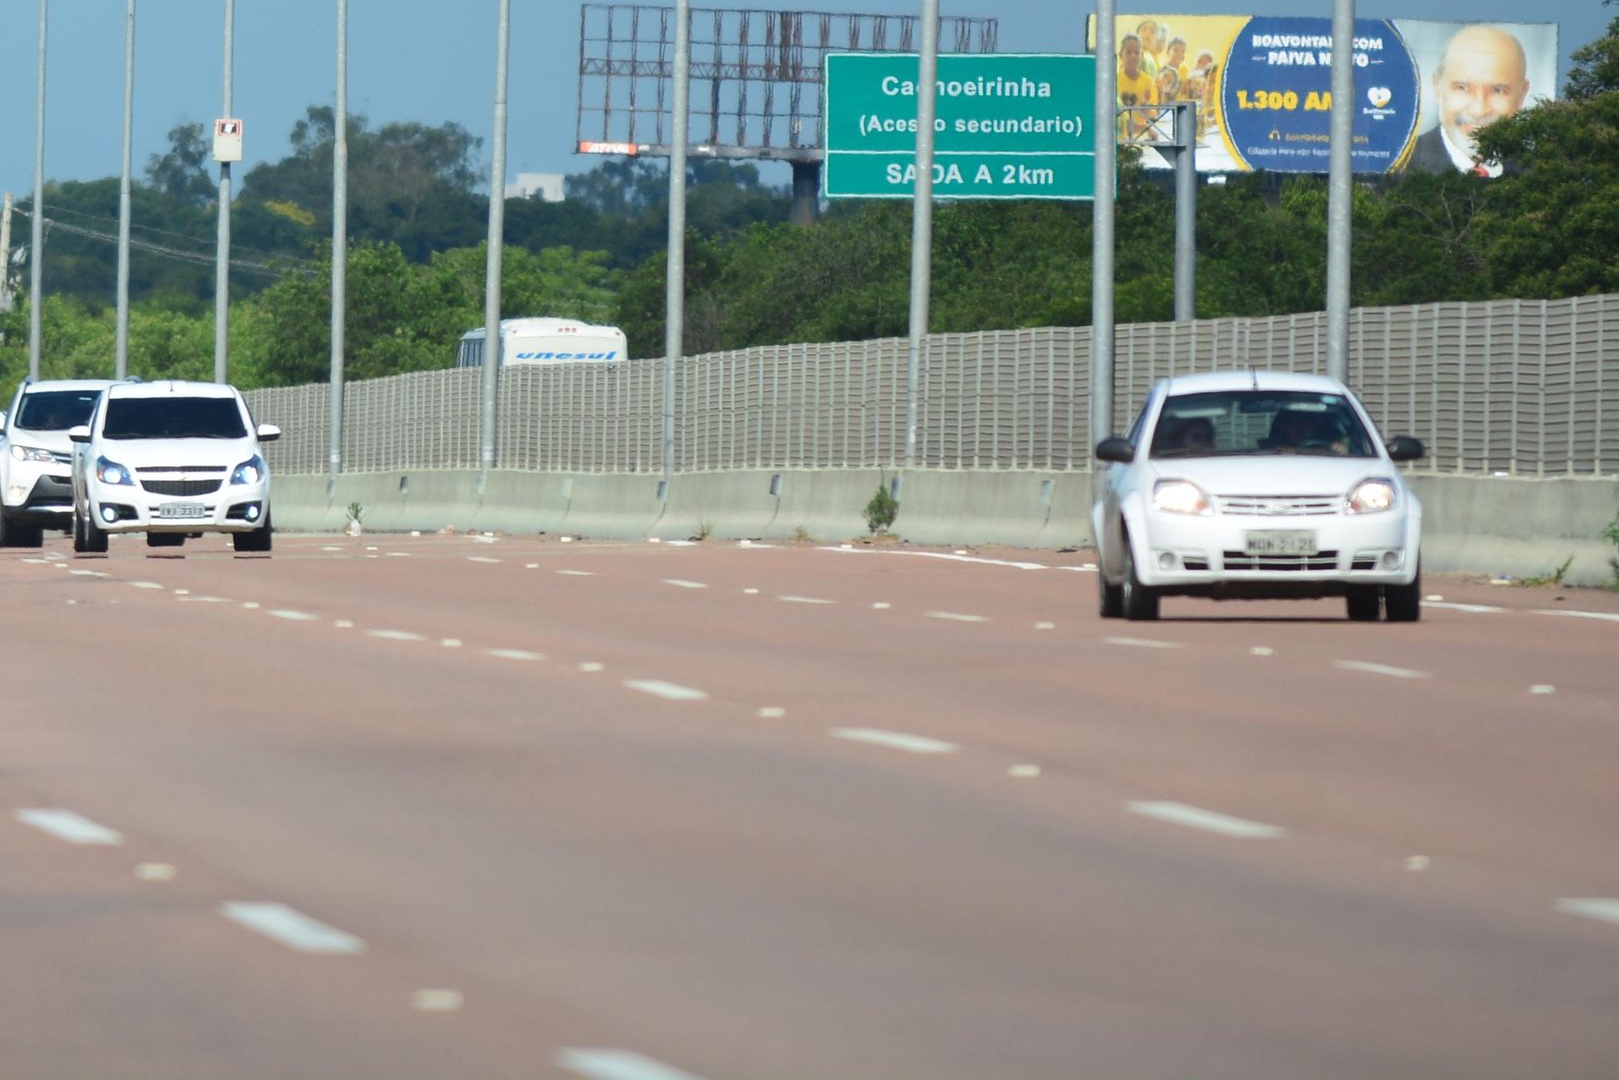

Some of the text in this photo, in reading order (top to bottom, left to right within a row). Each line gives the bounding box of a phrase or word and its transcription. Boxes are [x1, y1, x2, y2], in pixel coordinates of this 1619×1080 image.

[1268, 50, 1316, 66] PAIVA
[1236, 90, 1298, 110] 1.300
[859, 115, 1083, 137] (Aceso secundario)
[886, 163, 964, 184] SADA
[974, 164, 993, 184] A
